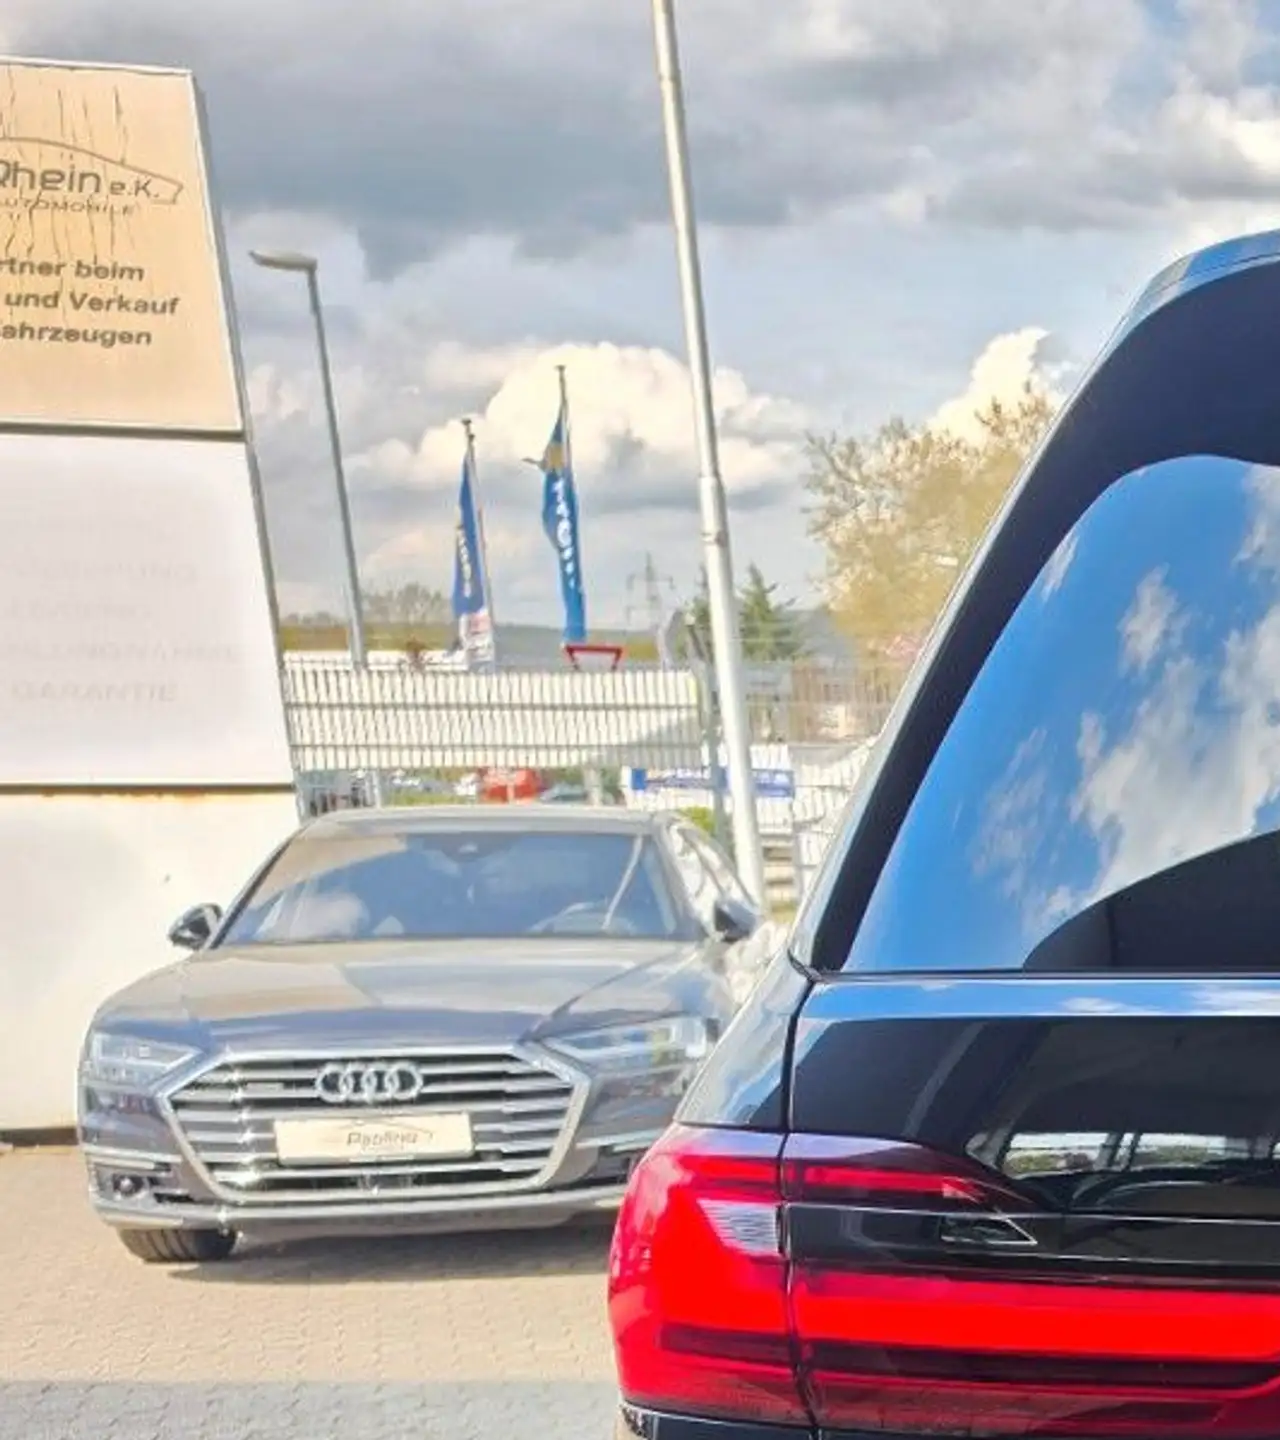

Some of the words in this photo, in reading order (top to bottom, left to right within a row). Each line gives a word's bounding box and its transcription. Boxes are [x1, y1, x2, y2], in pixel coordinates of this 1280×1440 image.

[109, 179, 160, 198] e.K.
[74, 259, 145, 282] beim
[5, 290, 60, 309] und
[69, 290, 181, 315] Verkauf
[0, 320, 153, 349] ahrzeugen
